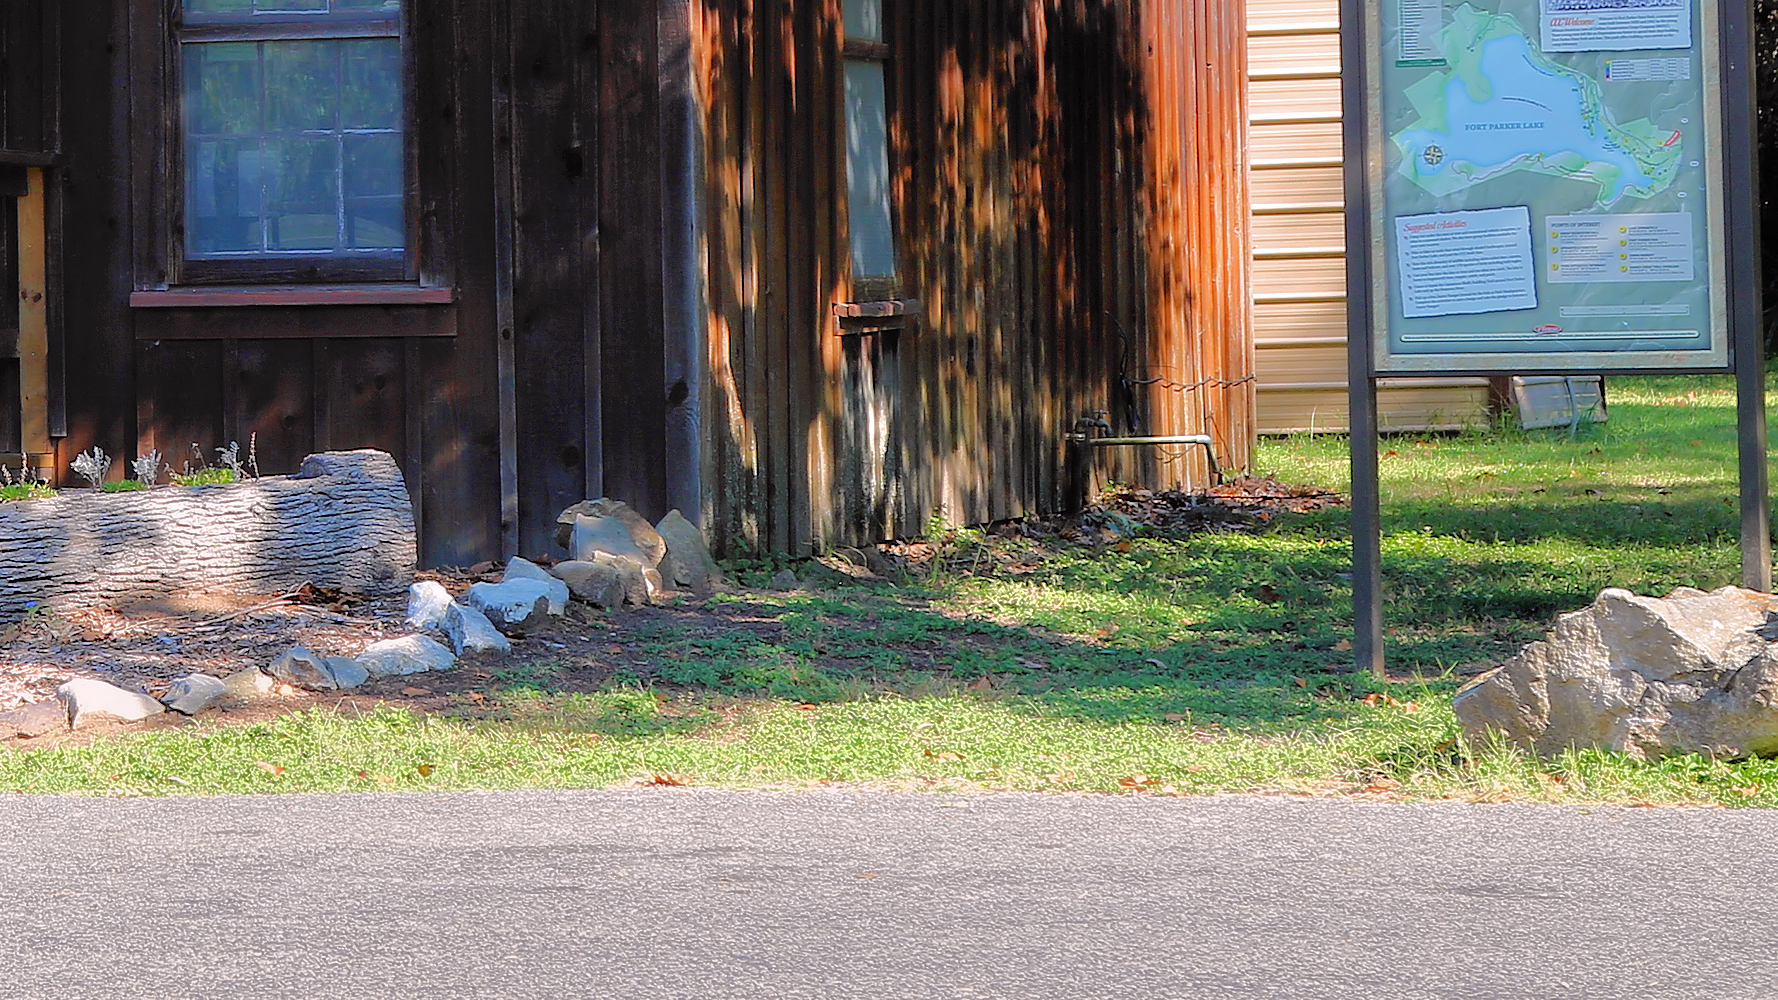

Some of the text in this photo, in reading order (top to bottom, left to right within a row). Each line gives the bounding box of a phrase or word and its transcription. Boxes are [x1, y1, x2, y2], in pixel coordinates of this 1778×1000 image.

[1465, 121, 1545, 131] FORT PARKER LAKE
